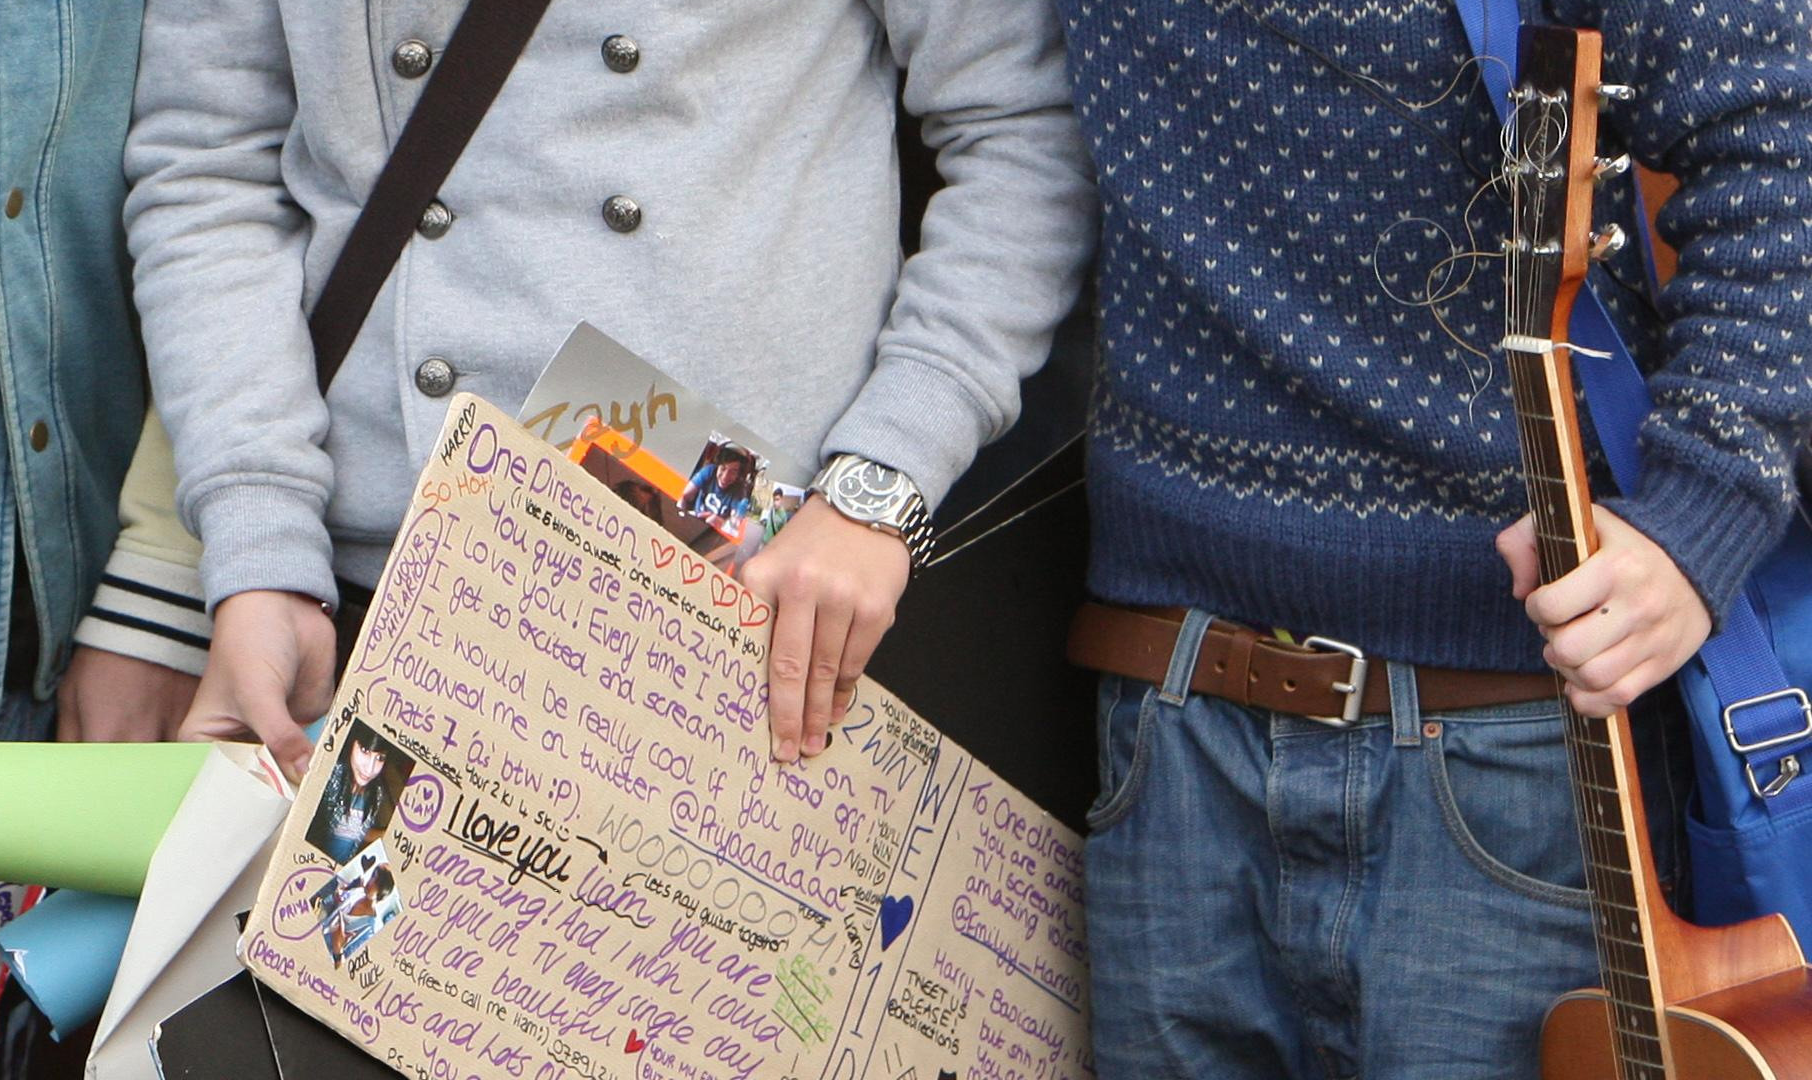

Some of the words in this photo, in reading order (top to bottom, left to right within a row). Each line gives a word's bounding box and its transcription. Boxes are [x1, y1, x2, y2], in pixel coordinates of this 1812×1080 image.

[466, 422, 527, 495] One
[531, 538, 582, 588] guys
[588, 565, 621, 602] are
[652, 580, 679, 606] vote
[441, 511, 460, 551] I
[462, 524, 527, 586] love
[587, 606, 640, 674] Every
[645, 640, 686, 690] time
[694, 670, 710, 702] I
[713, 693, 761, 733] see
[416, 603, 443, 648] It
[452, 632, 526, 701] would
[541, 679, 568, 720] be
[577, 703, 642, 773] really
[647, 741, 696, 785] cool
[707, 766, 727, 801] if
[737, 788, 782, 832] you
[427, 558, 449, 593] I
[448, 575, 483, 615] get
[487, 602, 511, 629] so
[517, 616, 588, 677] excited
[598, 665, 636, 705] and
[641, 691, 724, 753] scream
[736, 744, 776, 794] my
[775, 762, 824, 809] head
[391, 640, 485, 716] followed
[492, 700, 528, 741] me
[540, 728, 569, 760] on
[579, 741, 661, 803] twitter
[441, 714, 458, 753] 7
[499, 750, 543, 793] btw
[859, 724, 918, 792] WIN
[489, 780, 500, 799] 2
[518, 798, 528, 819] 4
[823, 766, 855, 797] on
[869, 785, 895, 815] TV
[967, 780, 993, 815] To
[461, 797, 520, 856] love
[507, 834, 572, 886] you
[1009, 849, 1036, 876] are
[968, 873, 1041, 940] amazing
[971, 844, 993, 873] TV
[1005, 872, 1074, 933] scream
[297, 964, 340, 1006] tweet
[407, 876, 448, 917] see
[435, 893, 494, 956] you
[487, 921, 521, 957] on
[531, 940, 567, 975] TV
[562, 960, 624, 1016] every
[616, 994, 694, 1045] single
[703, 1035, 765, 1079] day
[554, 897, 611, 955] And
[625, 951, 683, 995] wish
[707, 993, 796, 1053] could
[654, 916, 716, 968] you
[716, 953, 779, 998] are
[905, 968, 949, 1004] TWEET
[373, 978, 423, 1025] Lots
[422, 1011, 483, 1052] and
[441, 945, 484, 978] are
[490, 965, 613, 1047] beautiful
[460, 989, 481, 1011] call
[485, 1000, 507, 1021] me
